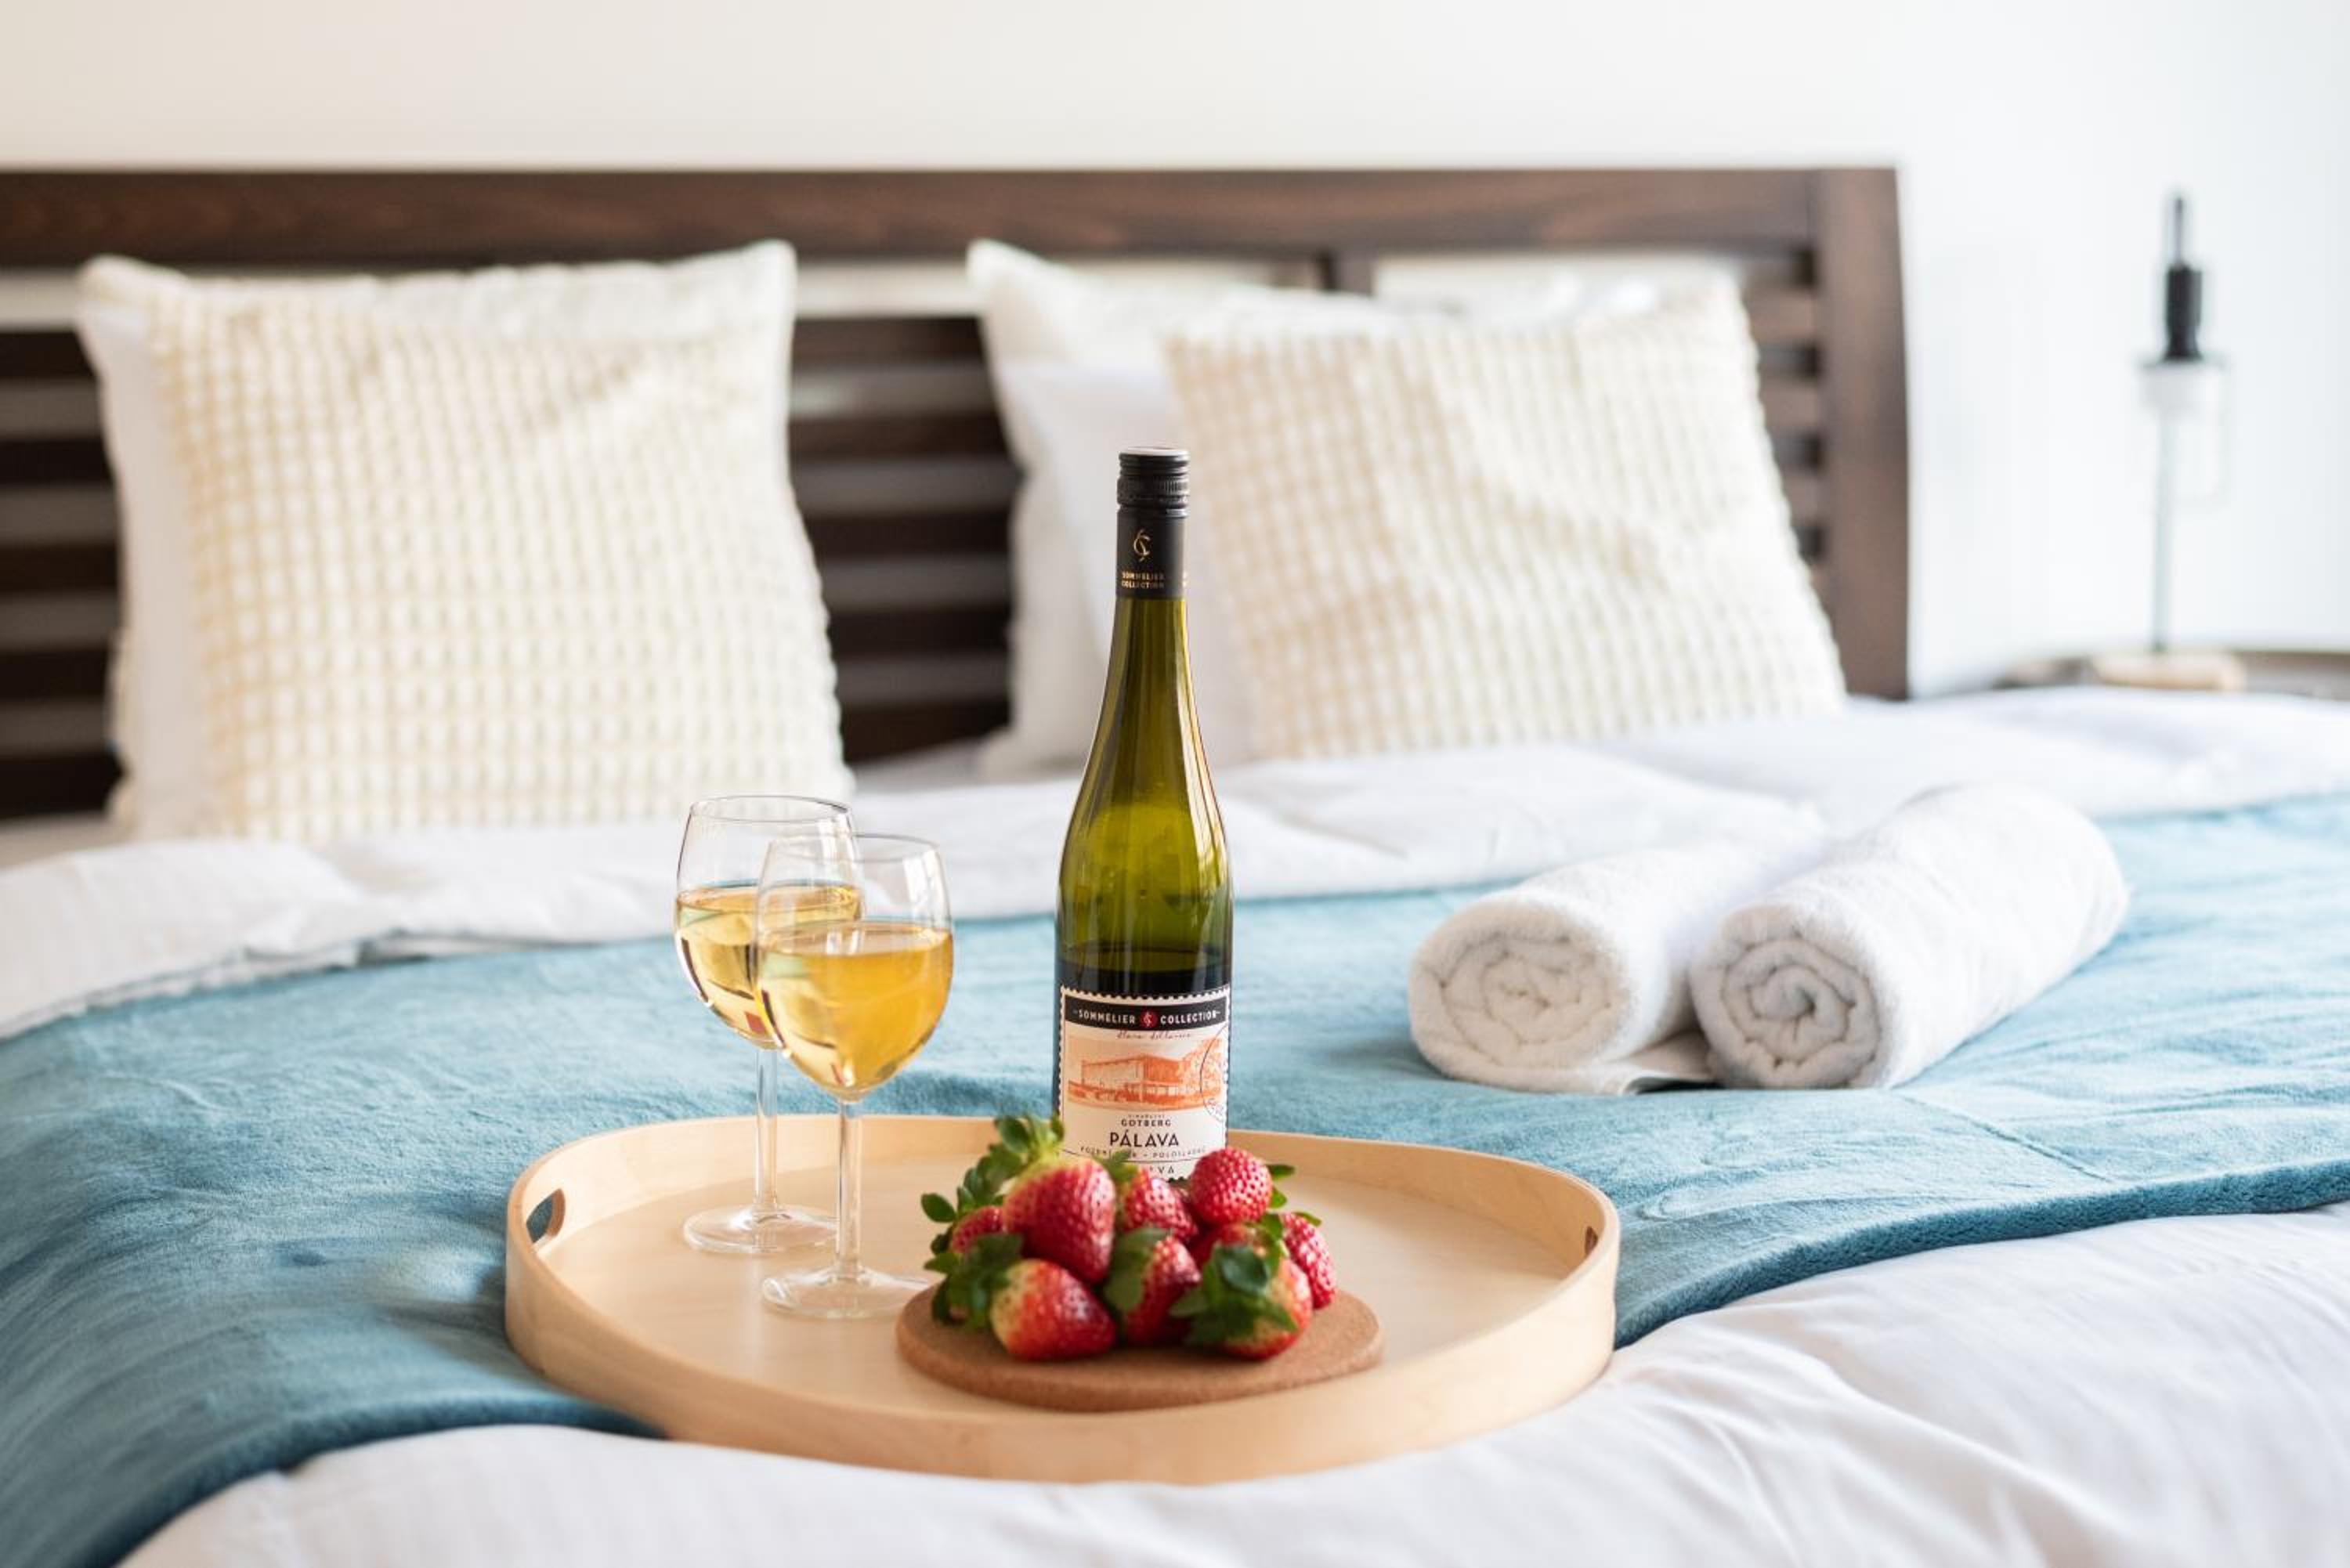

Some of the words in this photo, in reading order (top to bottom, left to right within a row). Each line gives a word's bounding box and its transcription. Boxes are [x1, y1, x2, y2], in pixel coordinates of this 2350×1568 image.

[1078, 1009, 1136, 1024] SOMMELIER
[1159, 1010, 1217, 1025] COLLECTION
[1121, 1118, 1171, 1127] GOTBERG
[1109, 1129, 1180, 1147] PÁLAVA
